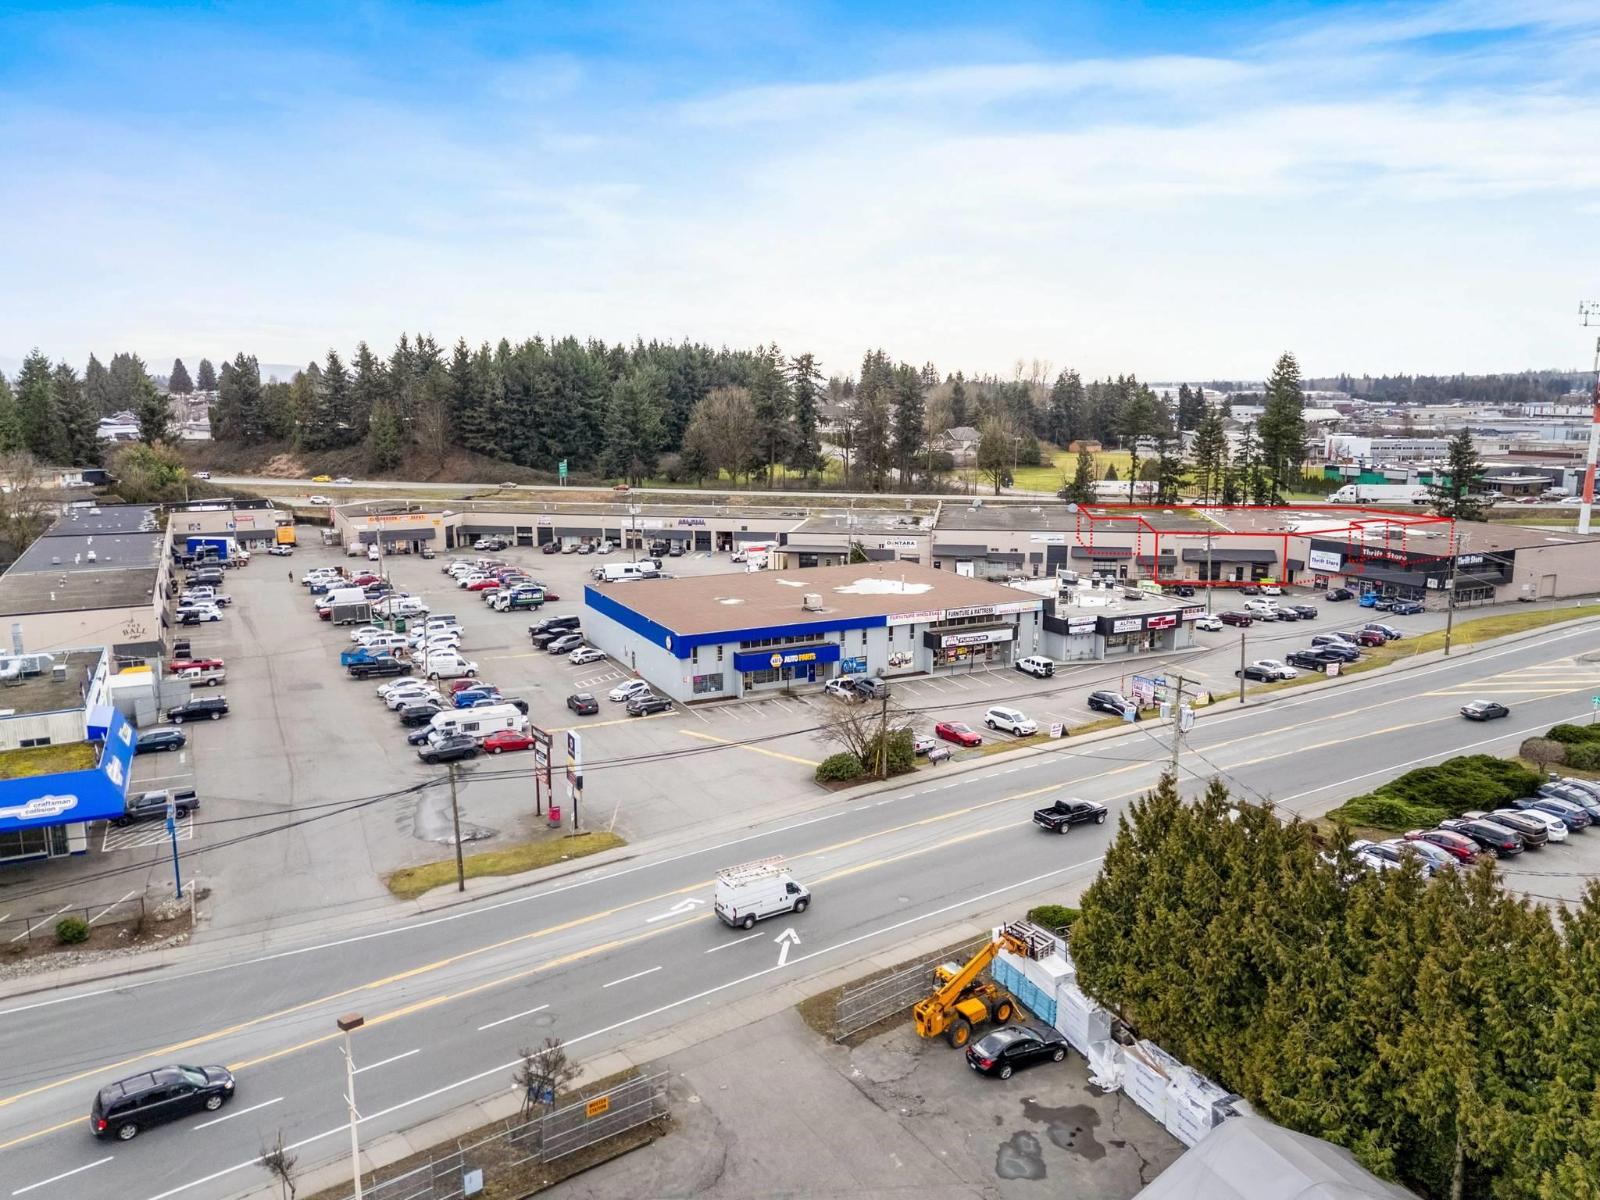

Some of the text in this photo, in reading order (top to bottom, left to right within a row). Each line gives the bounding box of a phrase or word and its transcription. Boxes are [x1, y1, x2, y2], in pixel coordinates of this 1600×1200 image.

[1363, 548, 1408, 561] Thrift Store
[1326, 559, 1339, 567] Store
[1457, 555, 1484, 565] Thrift Store
[948, 609, 970, 618] FURNITURE
[974, 607, 994, 615] MATTRESS
[784, 652, 816, 663] AUTO PARTS
[33, 799, 71, 808] craftsman
[25, 806, 56, 814] collision
